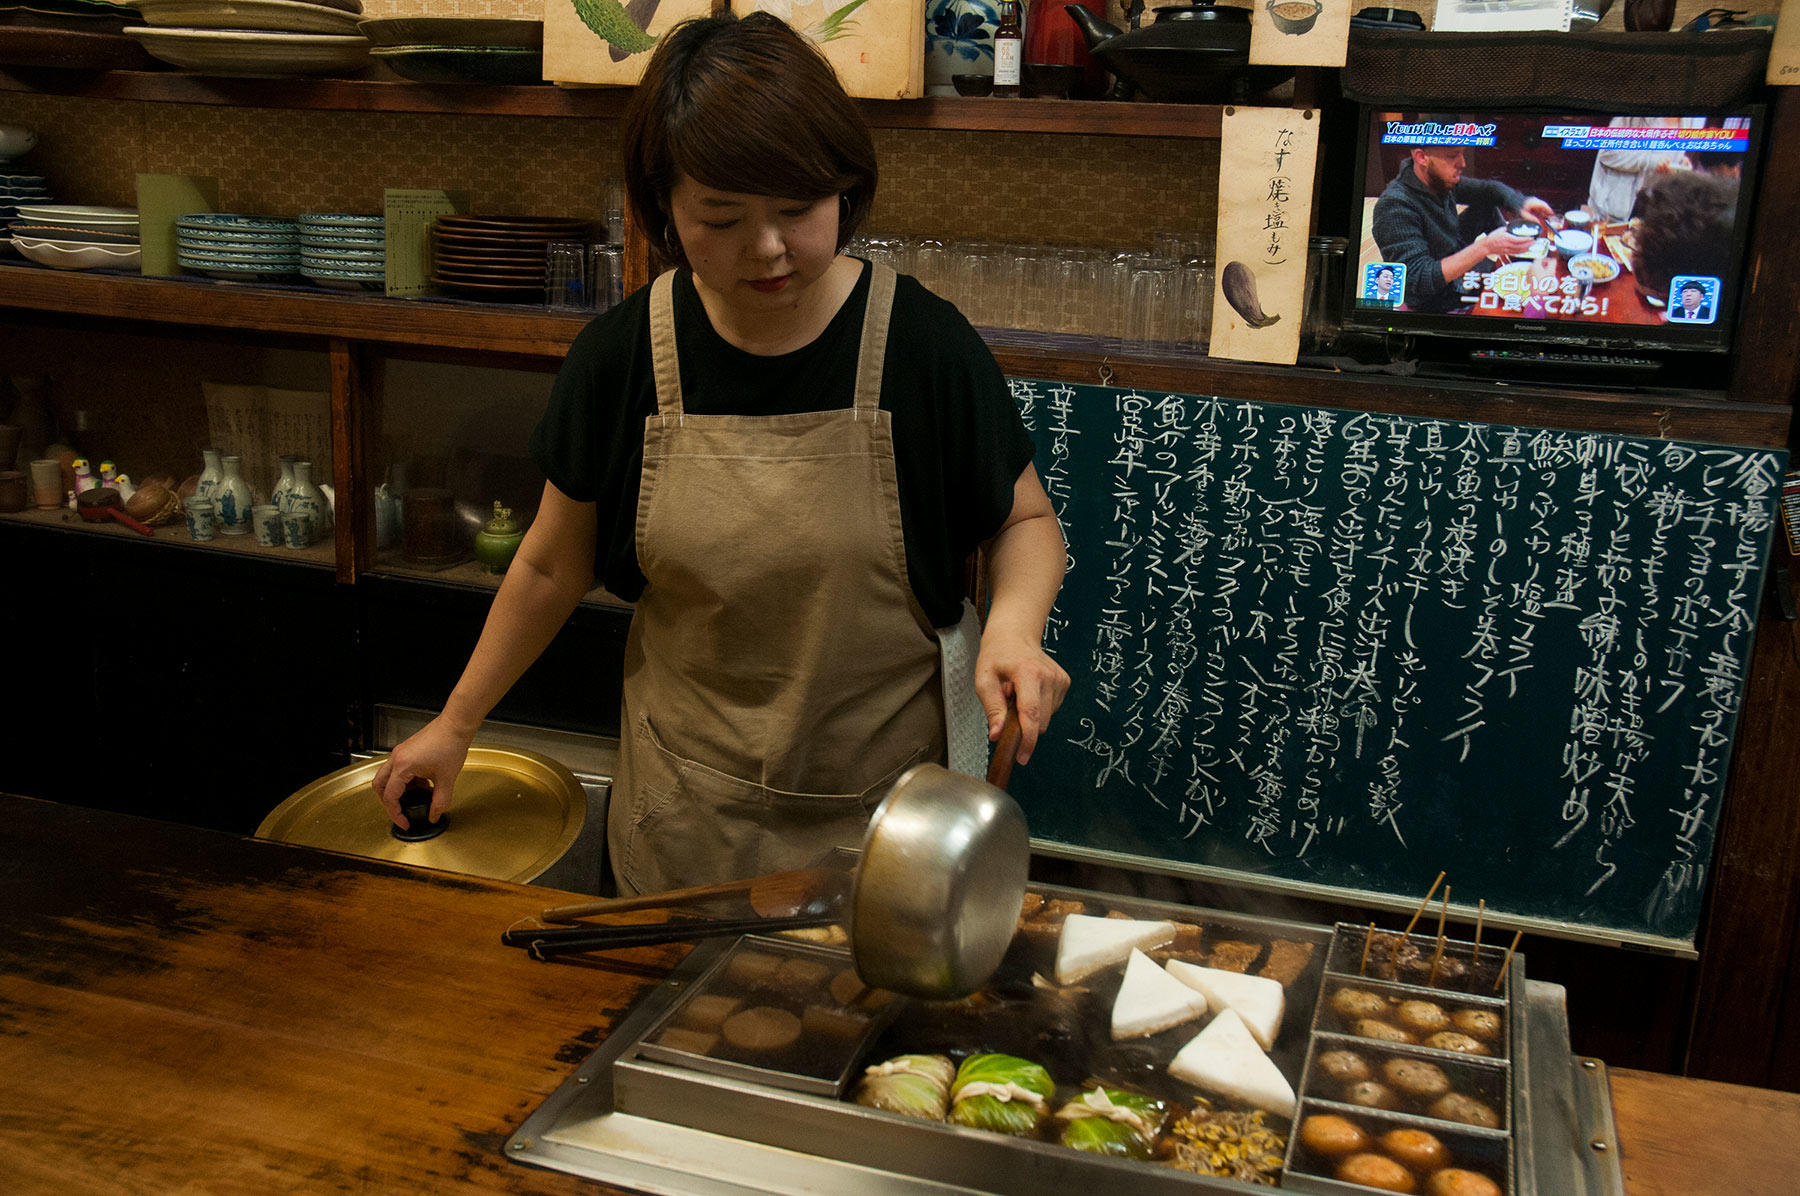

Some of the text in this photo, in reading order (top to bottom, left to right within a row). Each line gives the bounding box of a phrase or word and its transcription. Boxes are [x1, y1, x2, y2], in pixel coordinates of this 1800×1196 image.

[1463, 271, 1579, 294] まず白いのを
